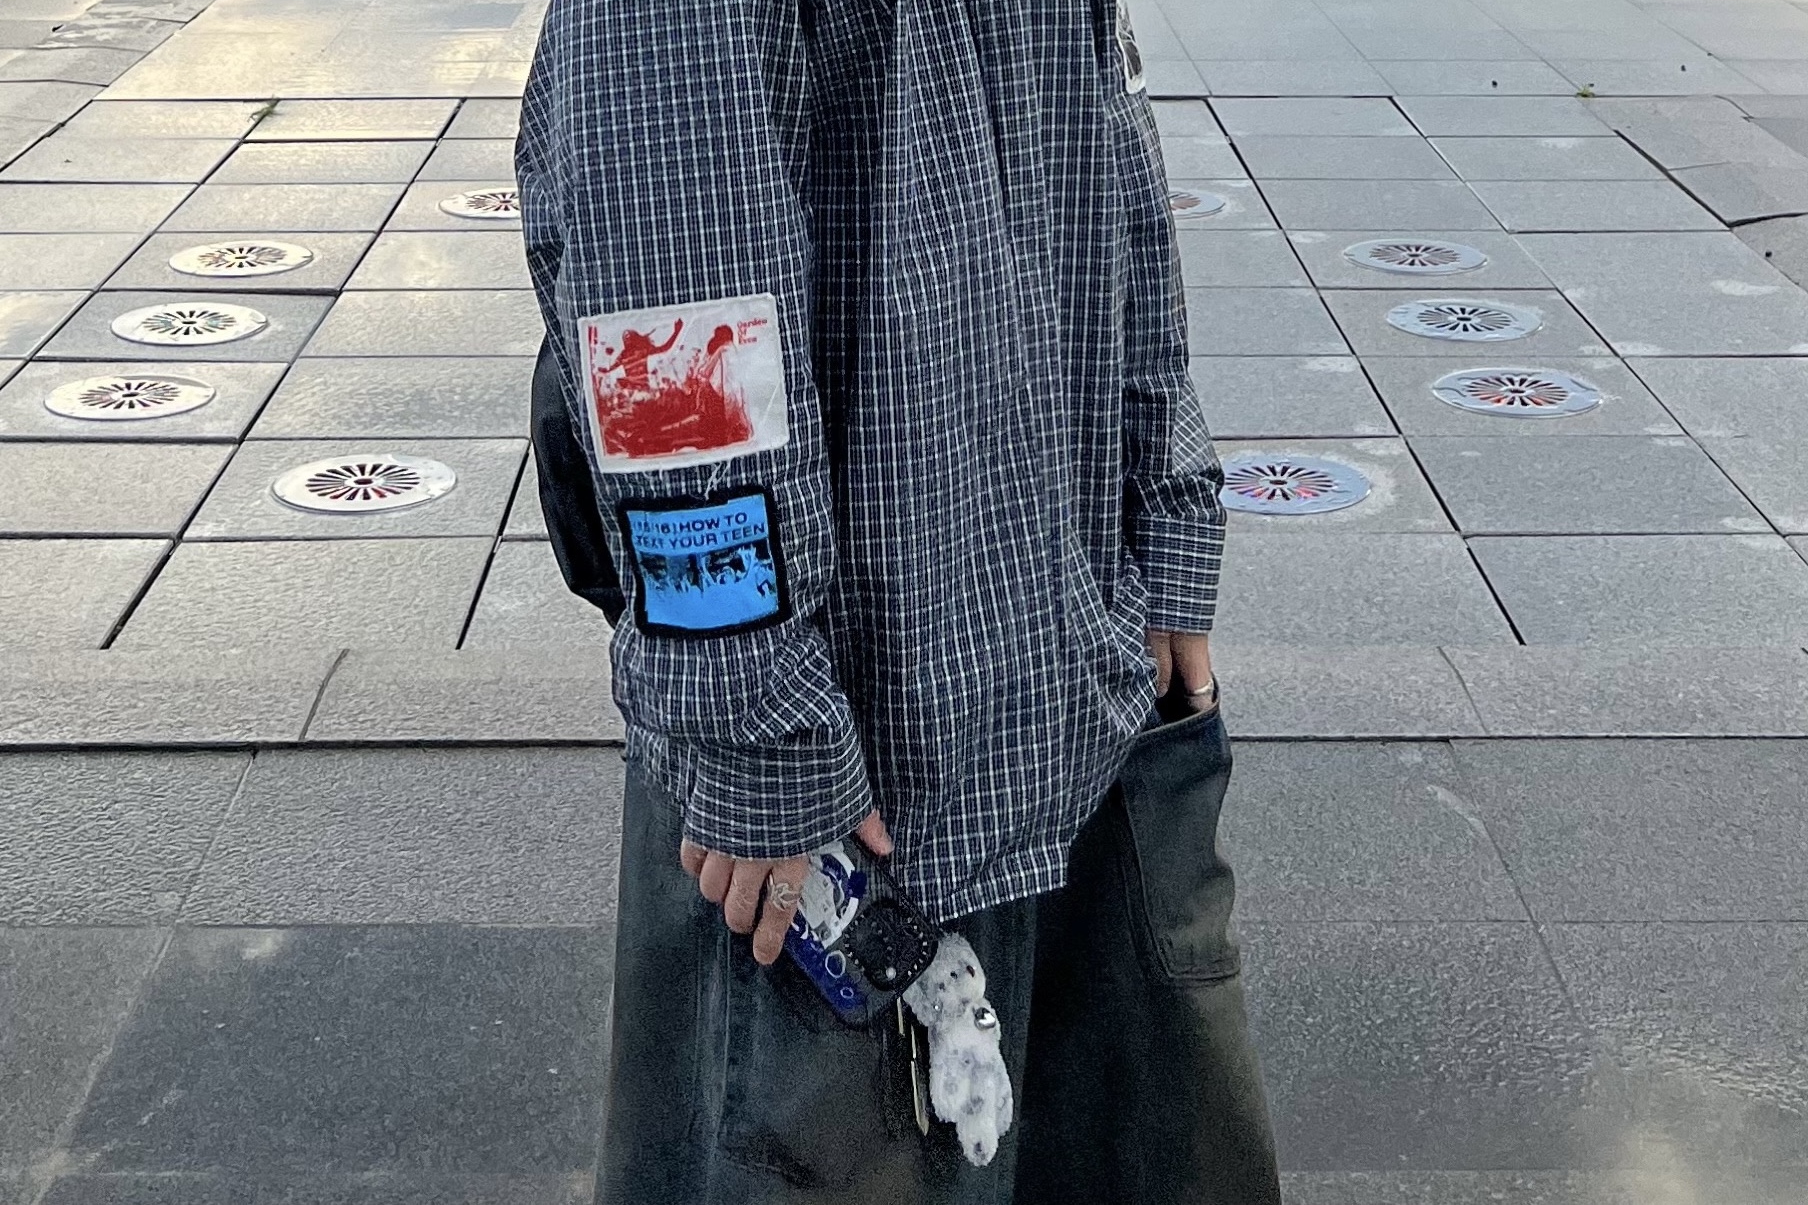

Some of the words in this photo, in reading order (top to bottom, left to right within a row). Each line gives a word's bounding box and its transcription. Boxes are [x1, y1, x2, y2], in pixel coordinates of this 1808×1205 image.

[679, 517, 720, 533] HOW
[723, 512, 748, 526] TO
[669, 532, 718, 550] YOUR
[721, 521, 765, 543] TEEN
